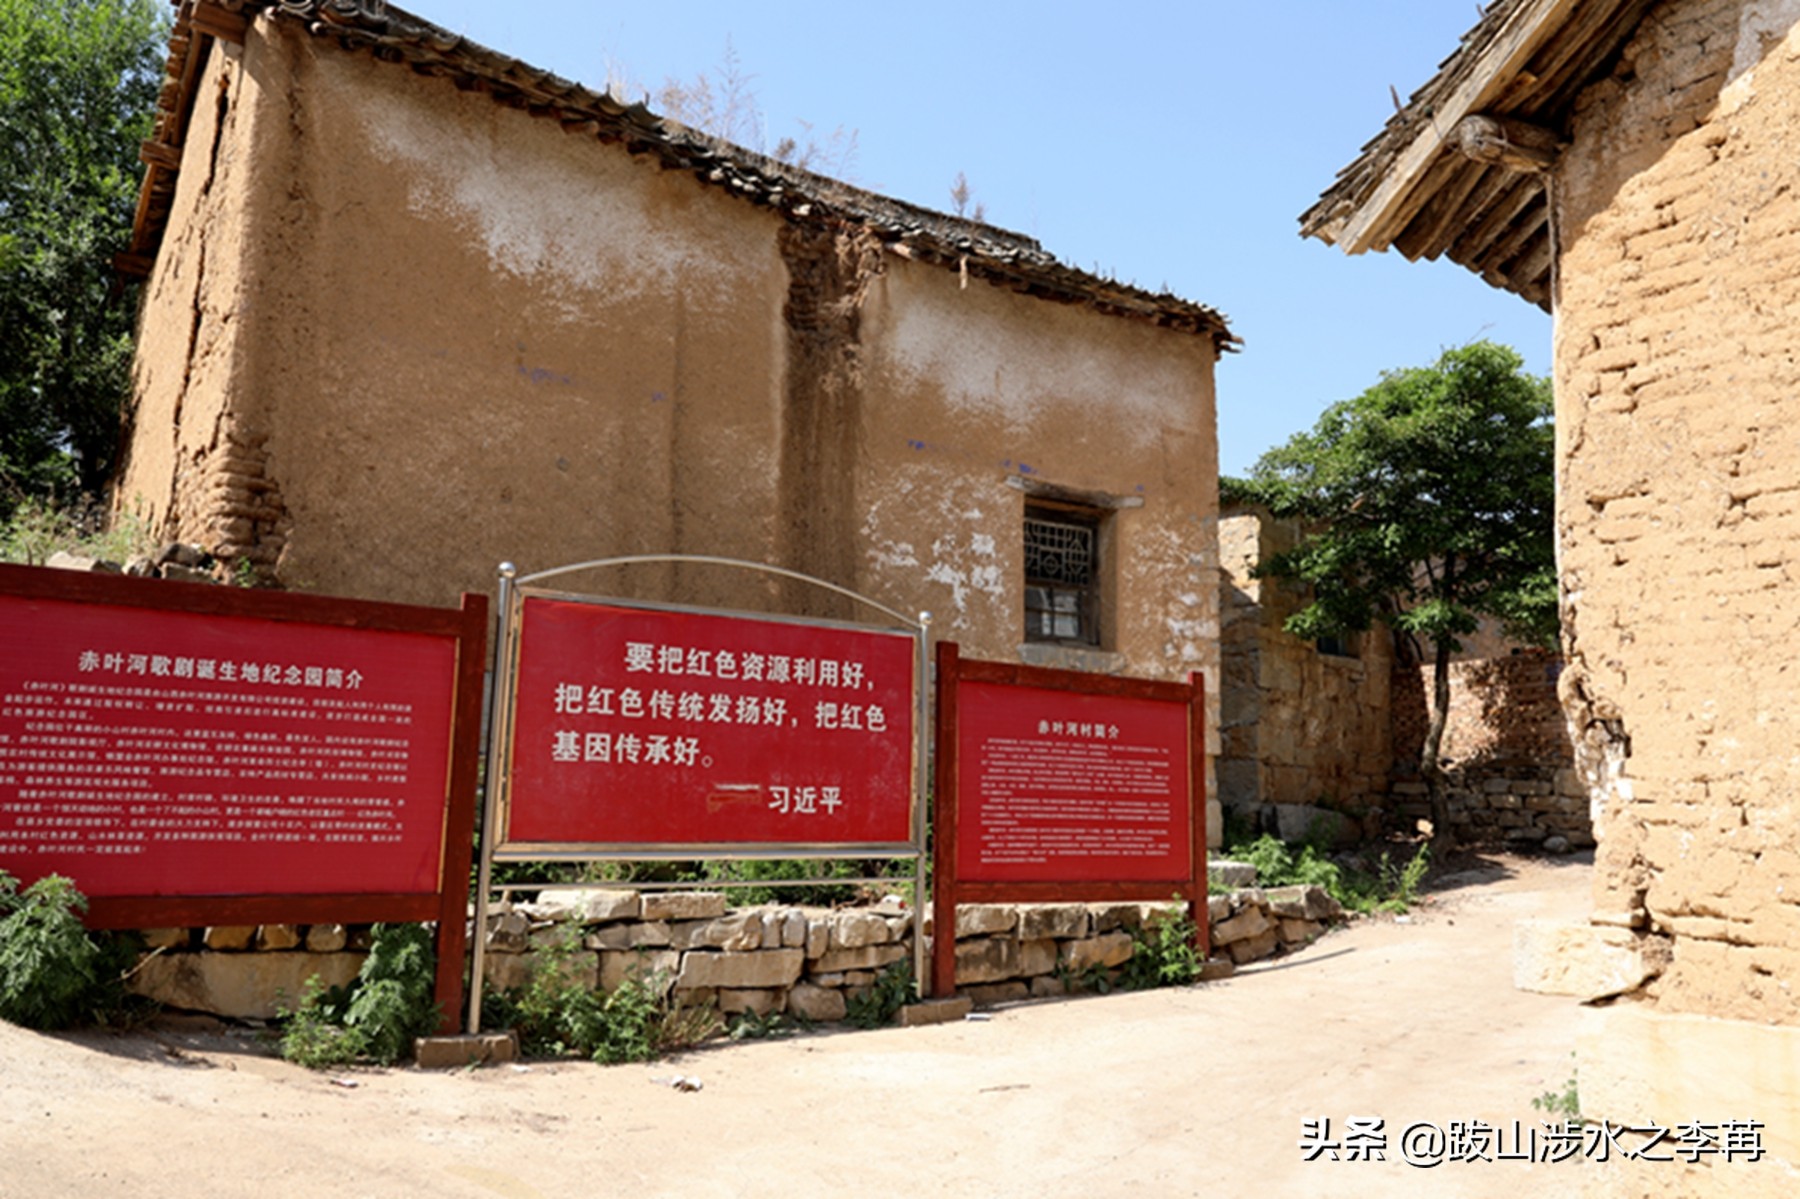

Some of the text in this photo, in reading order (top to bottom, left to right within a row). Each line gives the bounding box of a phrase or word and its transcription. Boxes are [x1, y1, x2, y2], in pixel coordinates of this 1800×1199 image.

[78, 650, 364, 689] 赤叶河歌剧诞生地纪念园简介
[624, 641, 876, 691] 要把红色资源利用好，
[553, 682, 888, 733] 把红色传统发扬好，把红色
[1037, 719, 1120, 739] 赤叶河村简介
[551, 730, 714, 768] 基因传承好。
